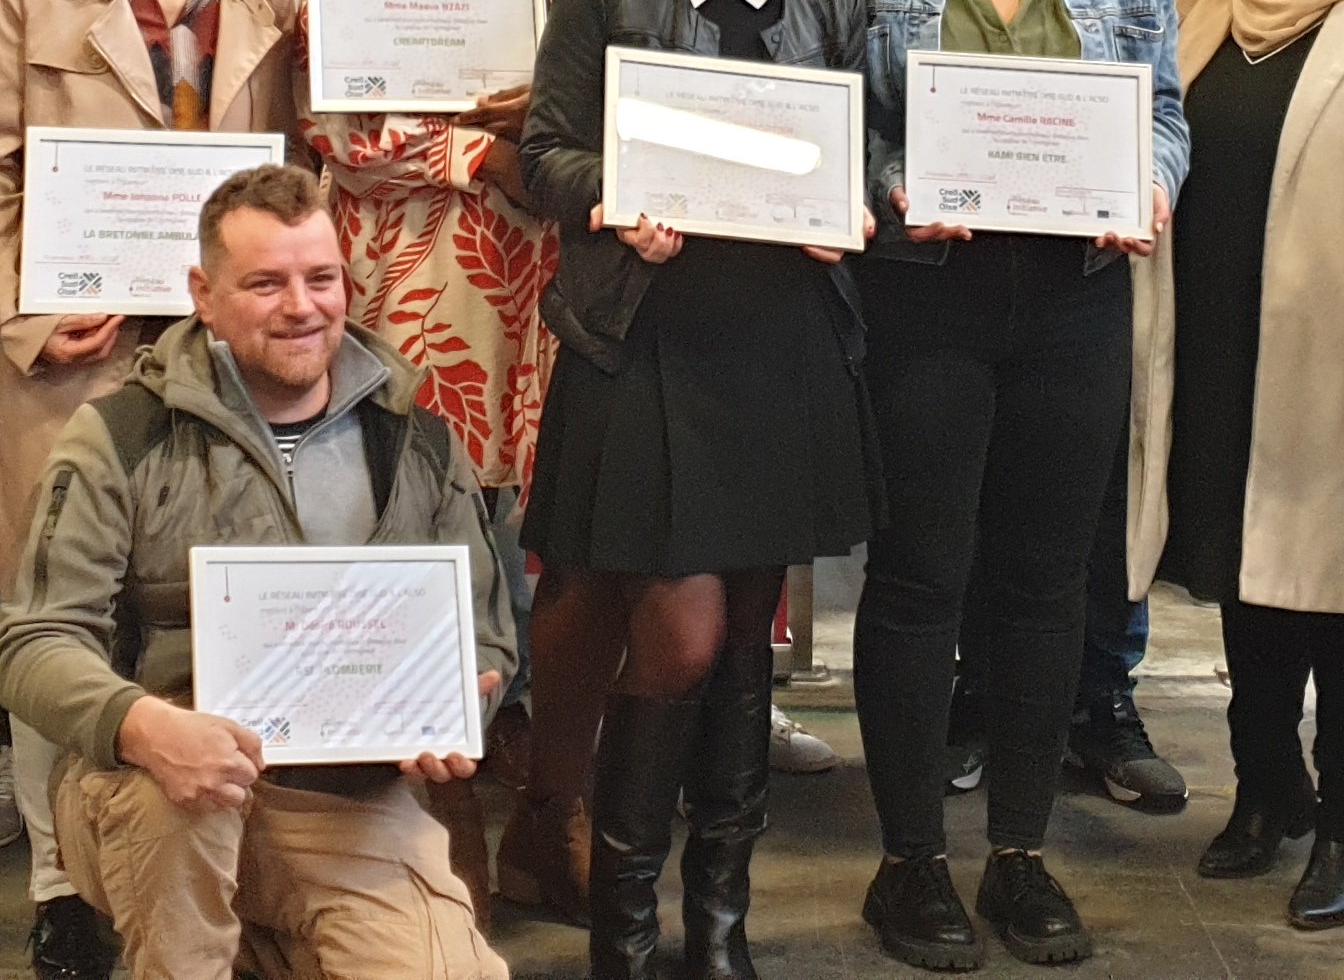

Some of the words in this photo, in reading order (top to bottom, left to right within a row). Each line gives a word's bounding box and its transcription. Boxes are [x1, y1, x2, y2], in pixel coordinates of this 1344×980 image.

[977, 112, 1001, 123] Mme
[1003, 114, 1037, 124] Camille
[1040, 117, 1075, 127] RACINE
[1016, 152, 1039, 162] BIEN
[103, 191, 128, 201] Mme
[939, 188, 958, 196] Creil
[939, 203, 957, 211] Oise
[58, 272, 79, 280] Creil
